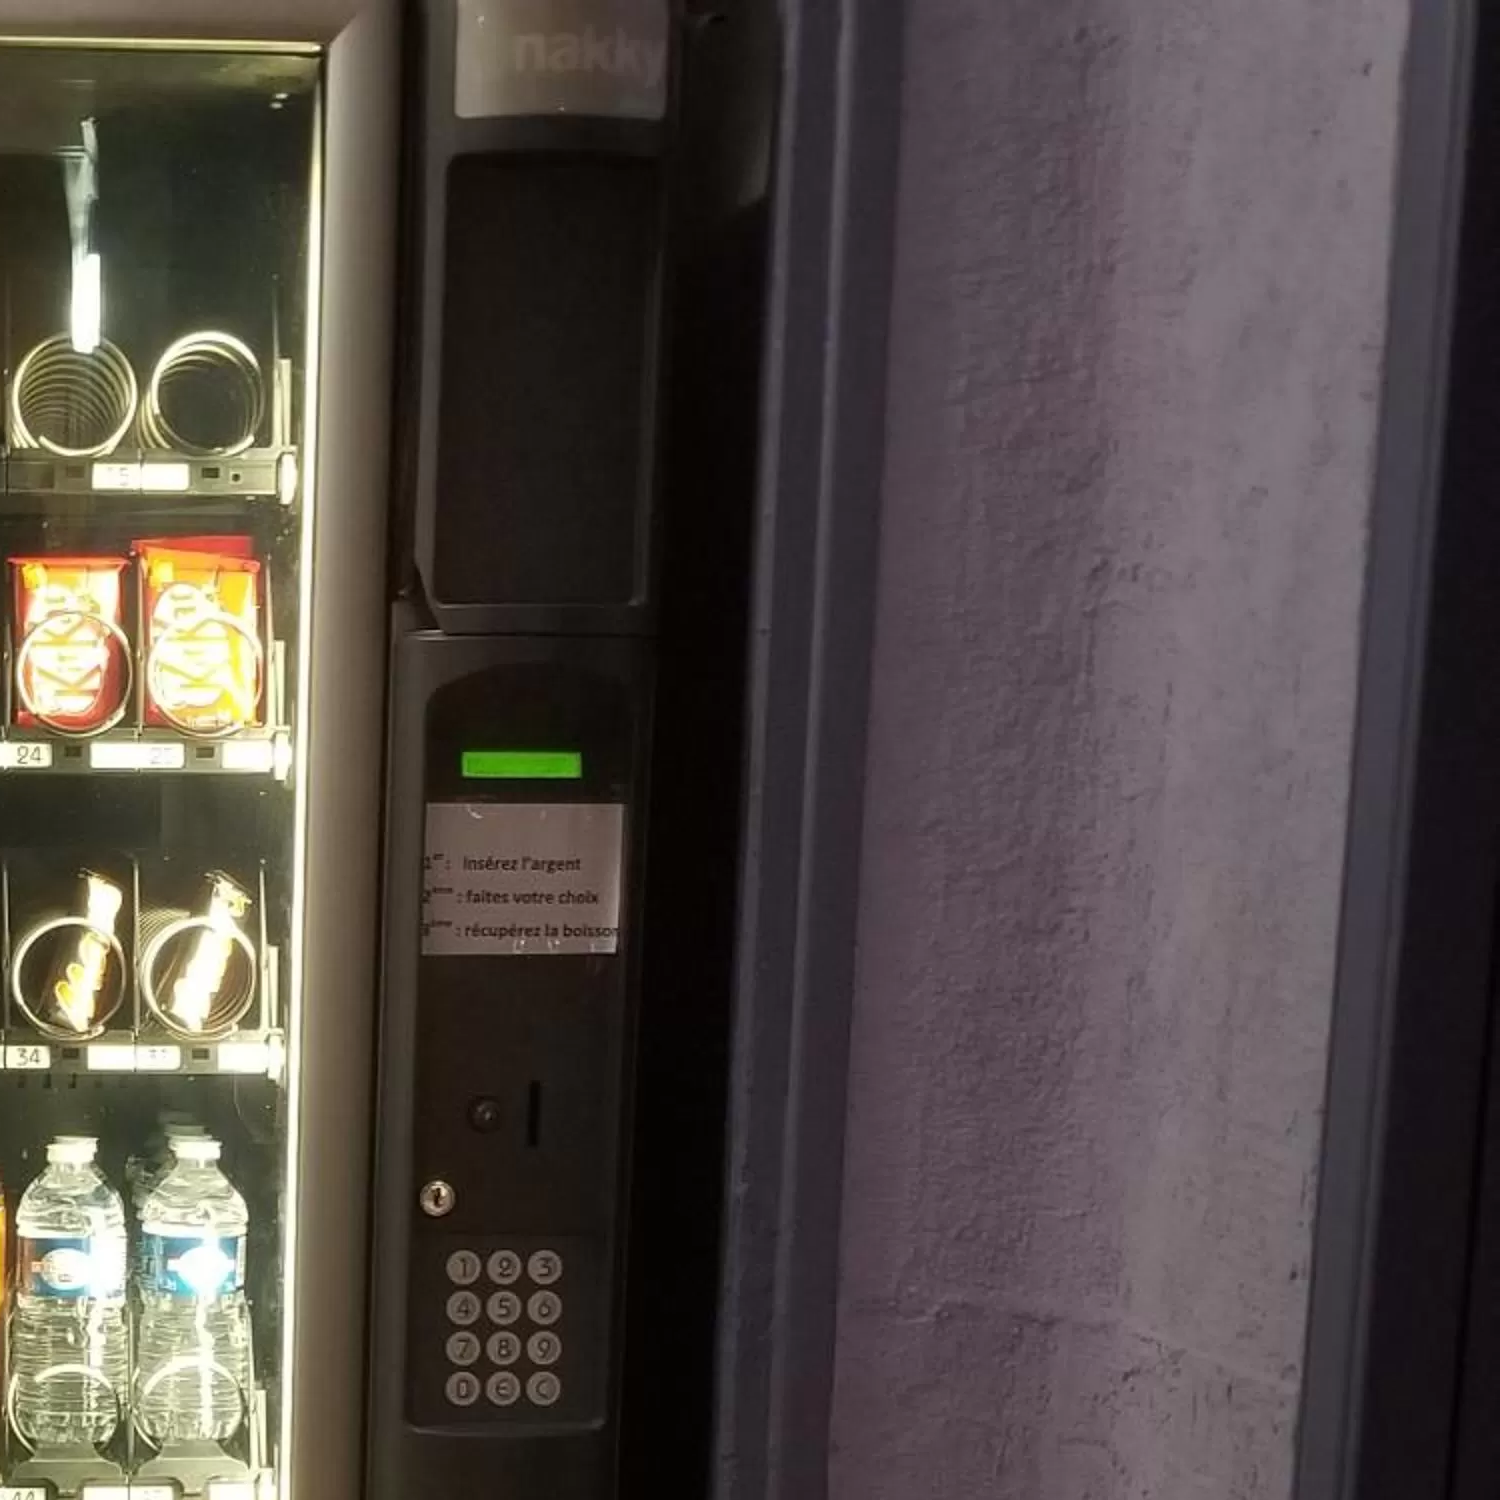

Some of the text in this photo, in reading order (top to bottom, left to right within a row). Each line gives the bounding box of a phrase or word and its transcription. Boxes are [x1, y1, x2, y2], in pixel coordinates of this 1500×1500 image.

[17, 745, 42, 763] 24
[463, 855, 517, 871] Insérez
[522, 856, 581, 873] l'argent
[466, 889, 509, 904] faites
[512, 891, 554, 904] votre
[558, 889, 599, 904] choix
[464, 922, 541, 940] récupérez
[545, 923, 559, 937] la
[16, 1047, 41, 1065] 34
[460, 1258, 551, 1277] 1 2 3
[455, 1299, 550, 1318] 4 5 6
[458, 1340, 549, 1358] 7 8 9
